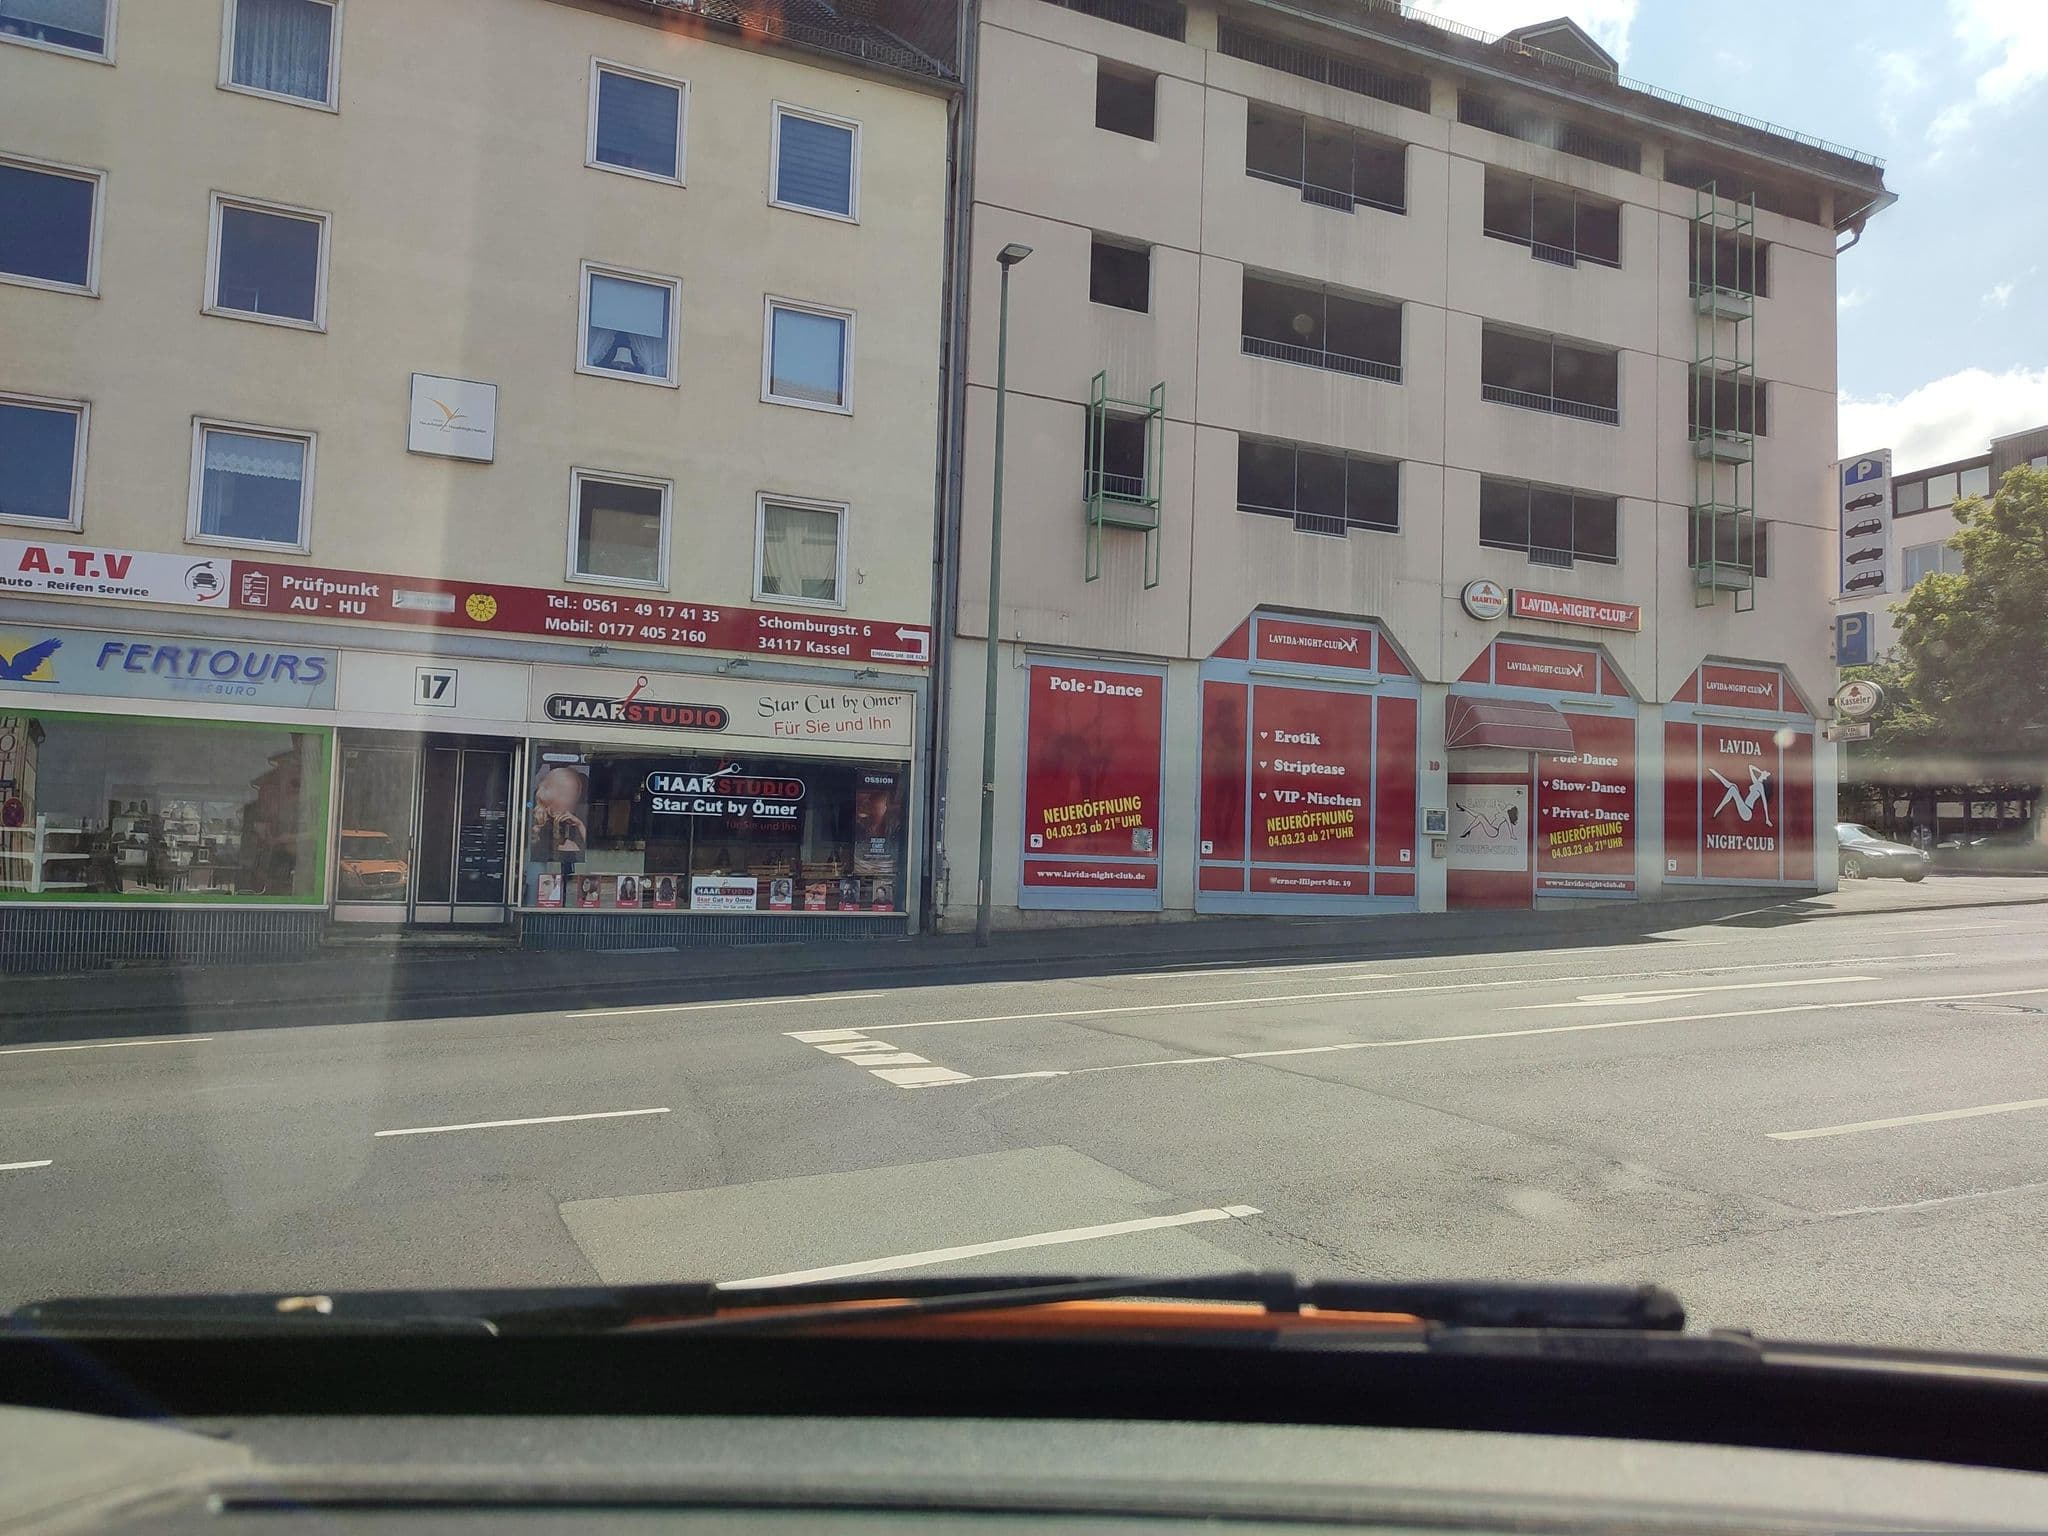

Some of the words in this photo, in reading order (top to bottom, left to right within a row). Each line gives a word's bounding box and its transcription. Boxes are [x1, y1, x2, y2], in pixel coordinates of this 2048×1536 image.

[1858, 460, 1872, 481] P
[18, 547, 133, 580] A.T.V
[0, 577, 33, 587] Auto
[47, 580, 94, 592] Reifen
[98, 584, 149, 597] Service
[282, 575, 380, 598] Prüfpunkt
[290, 595, 319, 611] AU
[339, 600, 367, 614] HU
[547, 595, 577, 609] Tel.:
[583, 598, 618, 613] 0561
[634, 603, 653, 616] 49
[658, 606, 675, 618] 17
[680, 608, 697, 620] 41
[702, 610, 720, 623] 35
[1472, 595, 1502, 605] MARTINI
[545, 617, 593, 633] Mobil:
[599, 622, 635, 636] 0177
[639, 626, 667, 639] 405
[671, 629, 707, 643] 2160
[758, 615, 859, 637] Schomburgstr.
[863, 625, 872, 637] 6
[1842, 617, 1863, 648] P
[758, 637, 801, 651] 34117
[806, 641, 850, 655] Kassel
[96, 641, 326, 683] FERTOURS
[421, 674, 452, 699] 17
[757, 696, 799, 717] Star
[804, 694, 835, 714] Cut
[842, 694, 858, 714] by
[1840, 695, 1871, 706] Kasseler
[774, 720, 800, 735] Für
[806, 719, 831, 734] Sie
[836, 717, 863, 732] und
[868, 716, 892, 730] Ihn
[1274, 730, 1321, 745] Erotik
[1719, 738, 1762, 756] LAVIDA
[1274, 759, 1346, 776] Striptease
[864, 776, 894, 785] OSSION
[652, 797, 689, 812] Star
[693, 799, 722, 813] Cut
[727, 800, 747, 817] by
[752, 799, 797, 816] Ömer
[1044, 796, 1142, 824] NEUERÖFFNUNG
[1046, 822, 1087, 840] 04.03.23
[1090, 820, 1102, 834] ab
[1122, 814, 1143, 829] UHR
[1267, 809, 1354, 833] NEUERÖFFNUNG
[1268, 832, 1305, 848] 04.03.23
[1308, 830, 1319, 843] ab
[1336, 826, 1354, 840] UHR
[1549, 821, 1623, 846] NEUERÖFFNUNG
[1551, 844, 1583, 860] 04.03.23
[1584, 842, 1594, 854] ab
[1608, 837, 1624, 850] UHR
[1037, 870, 1146, 881] www.lavida-night-club.de
[1343, 879, 1352, 887] 19
